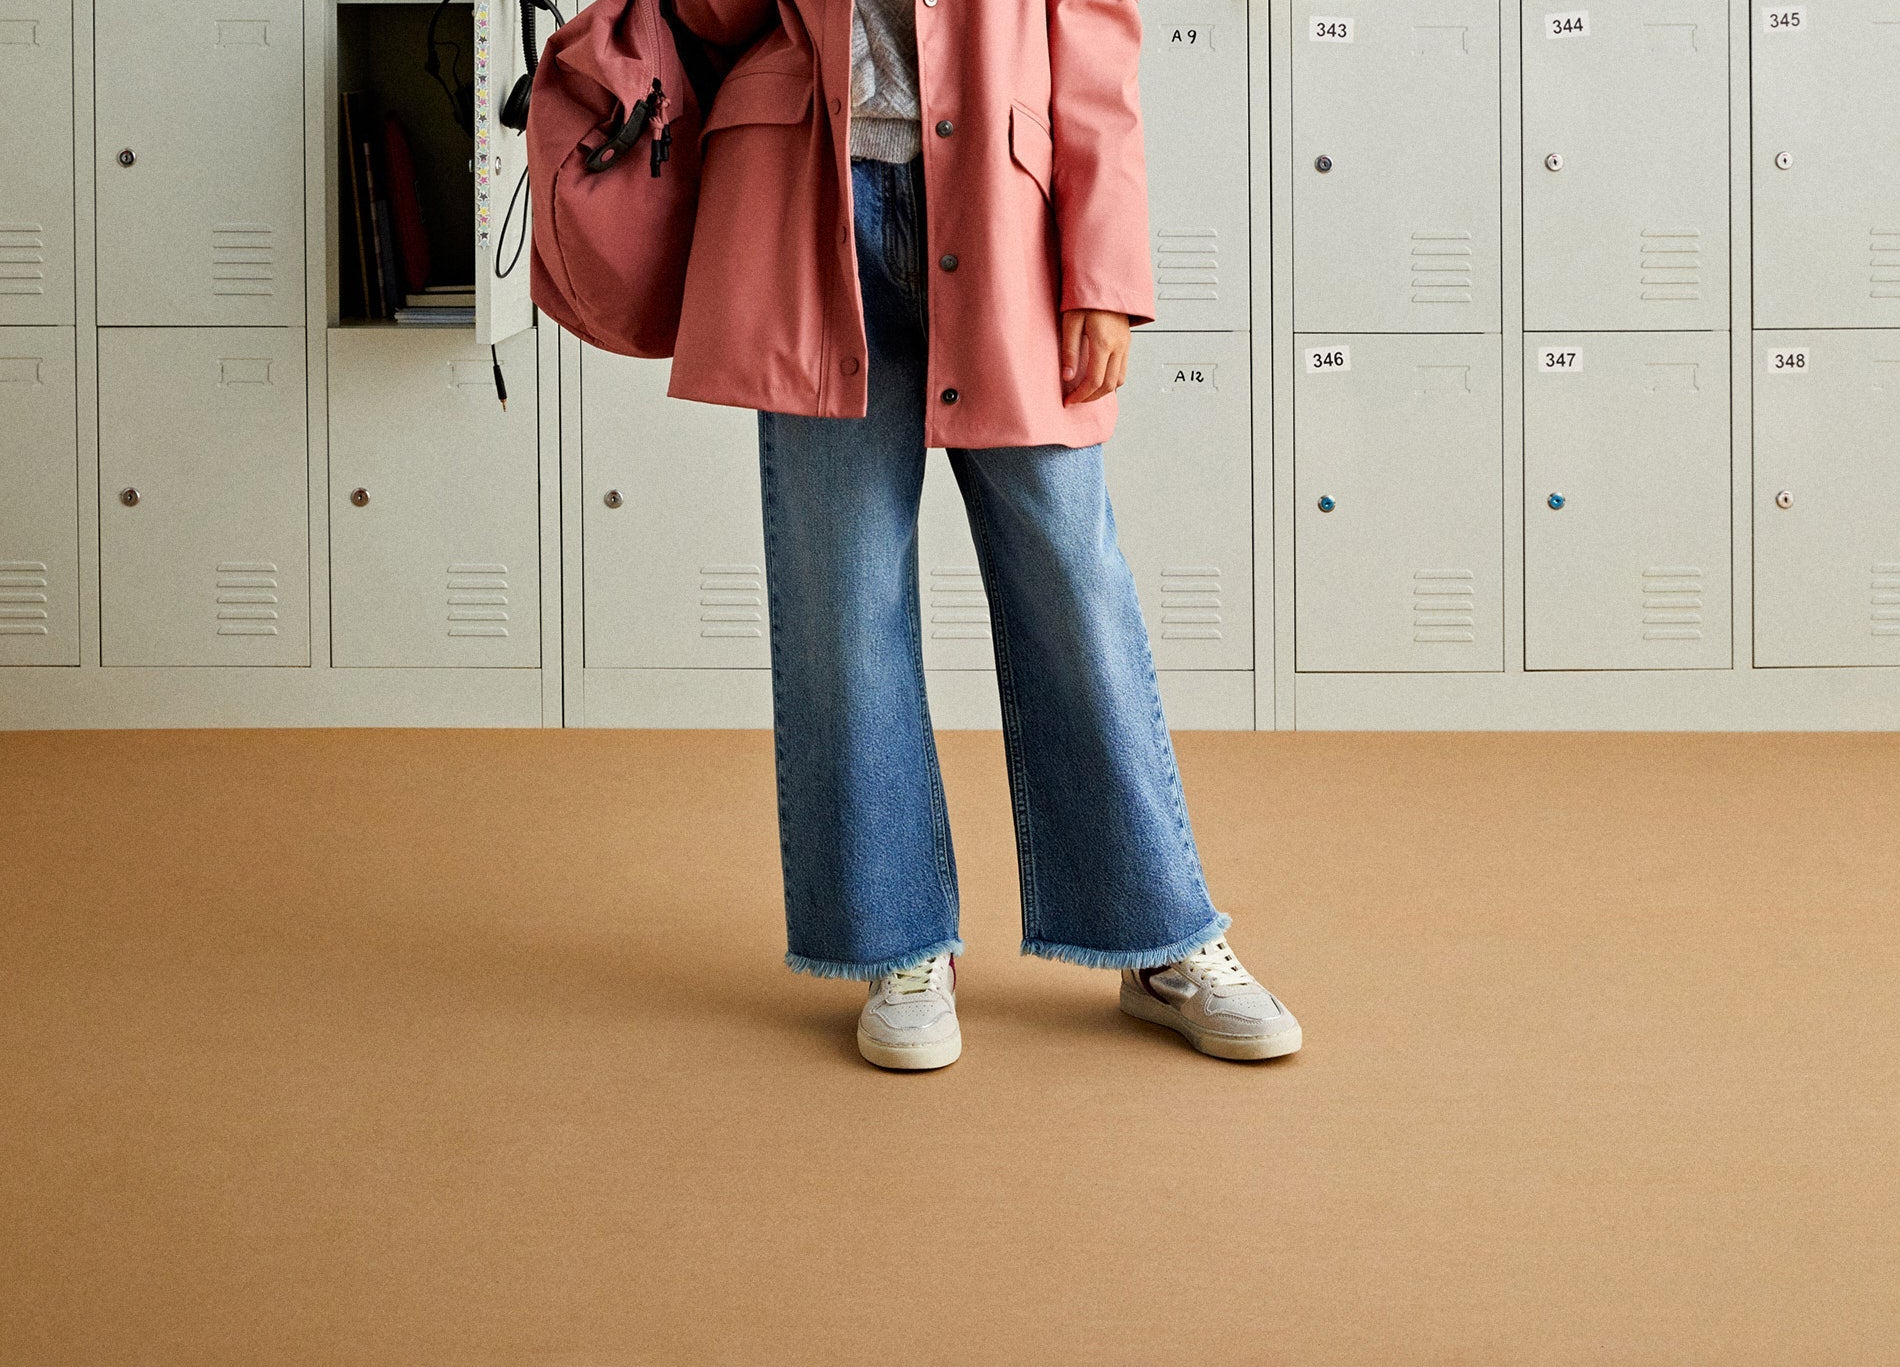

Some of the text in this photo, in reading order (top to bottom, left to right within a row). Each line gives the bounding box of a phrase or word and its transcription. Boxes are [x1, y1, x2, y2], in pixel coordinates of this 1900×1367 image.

[1552, 17, 1584, 35] 344
[1770, 12, 1800, 28] 345
[1316, 22, 1347, 38] 343
[1313, 351, 1344, 368] 346
[1545, 352, 1576, 368] 347
[1775, 353, 1805, 369] 348
